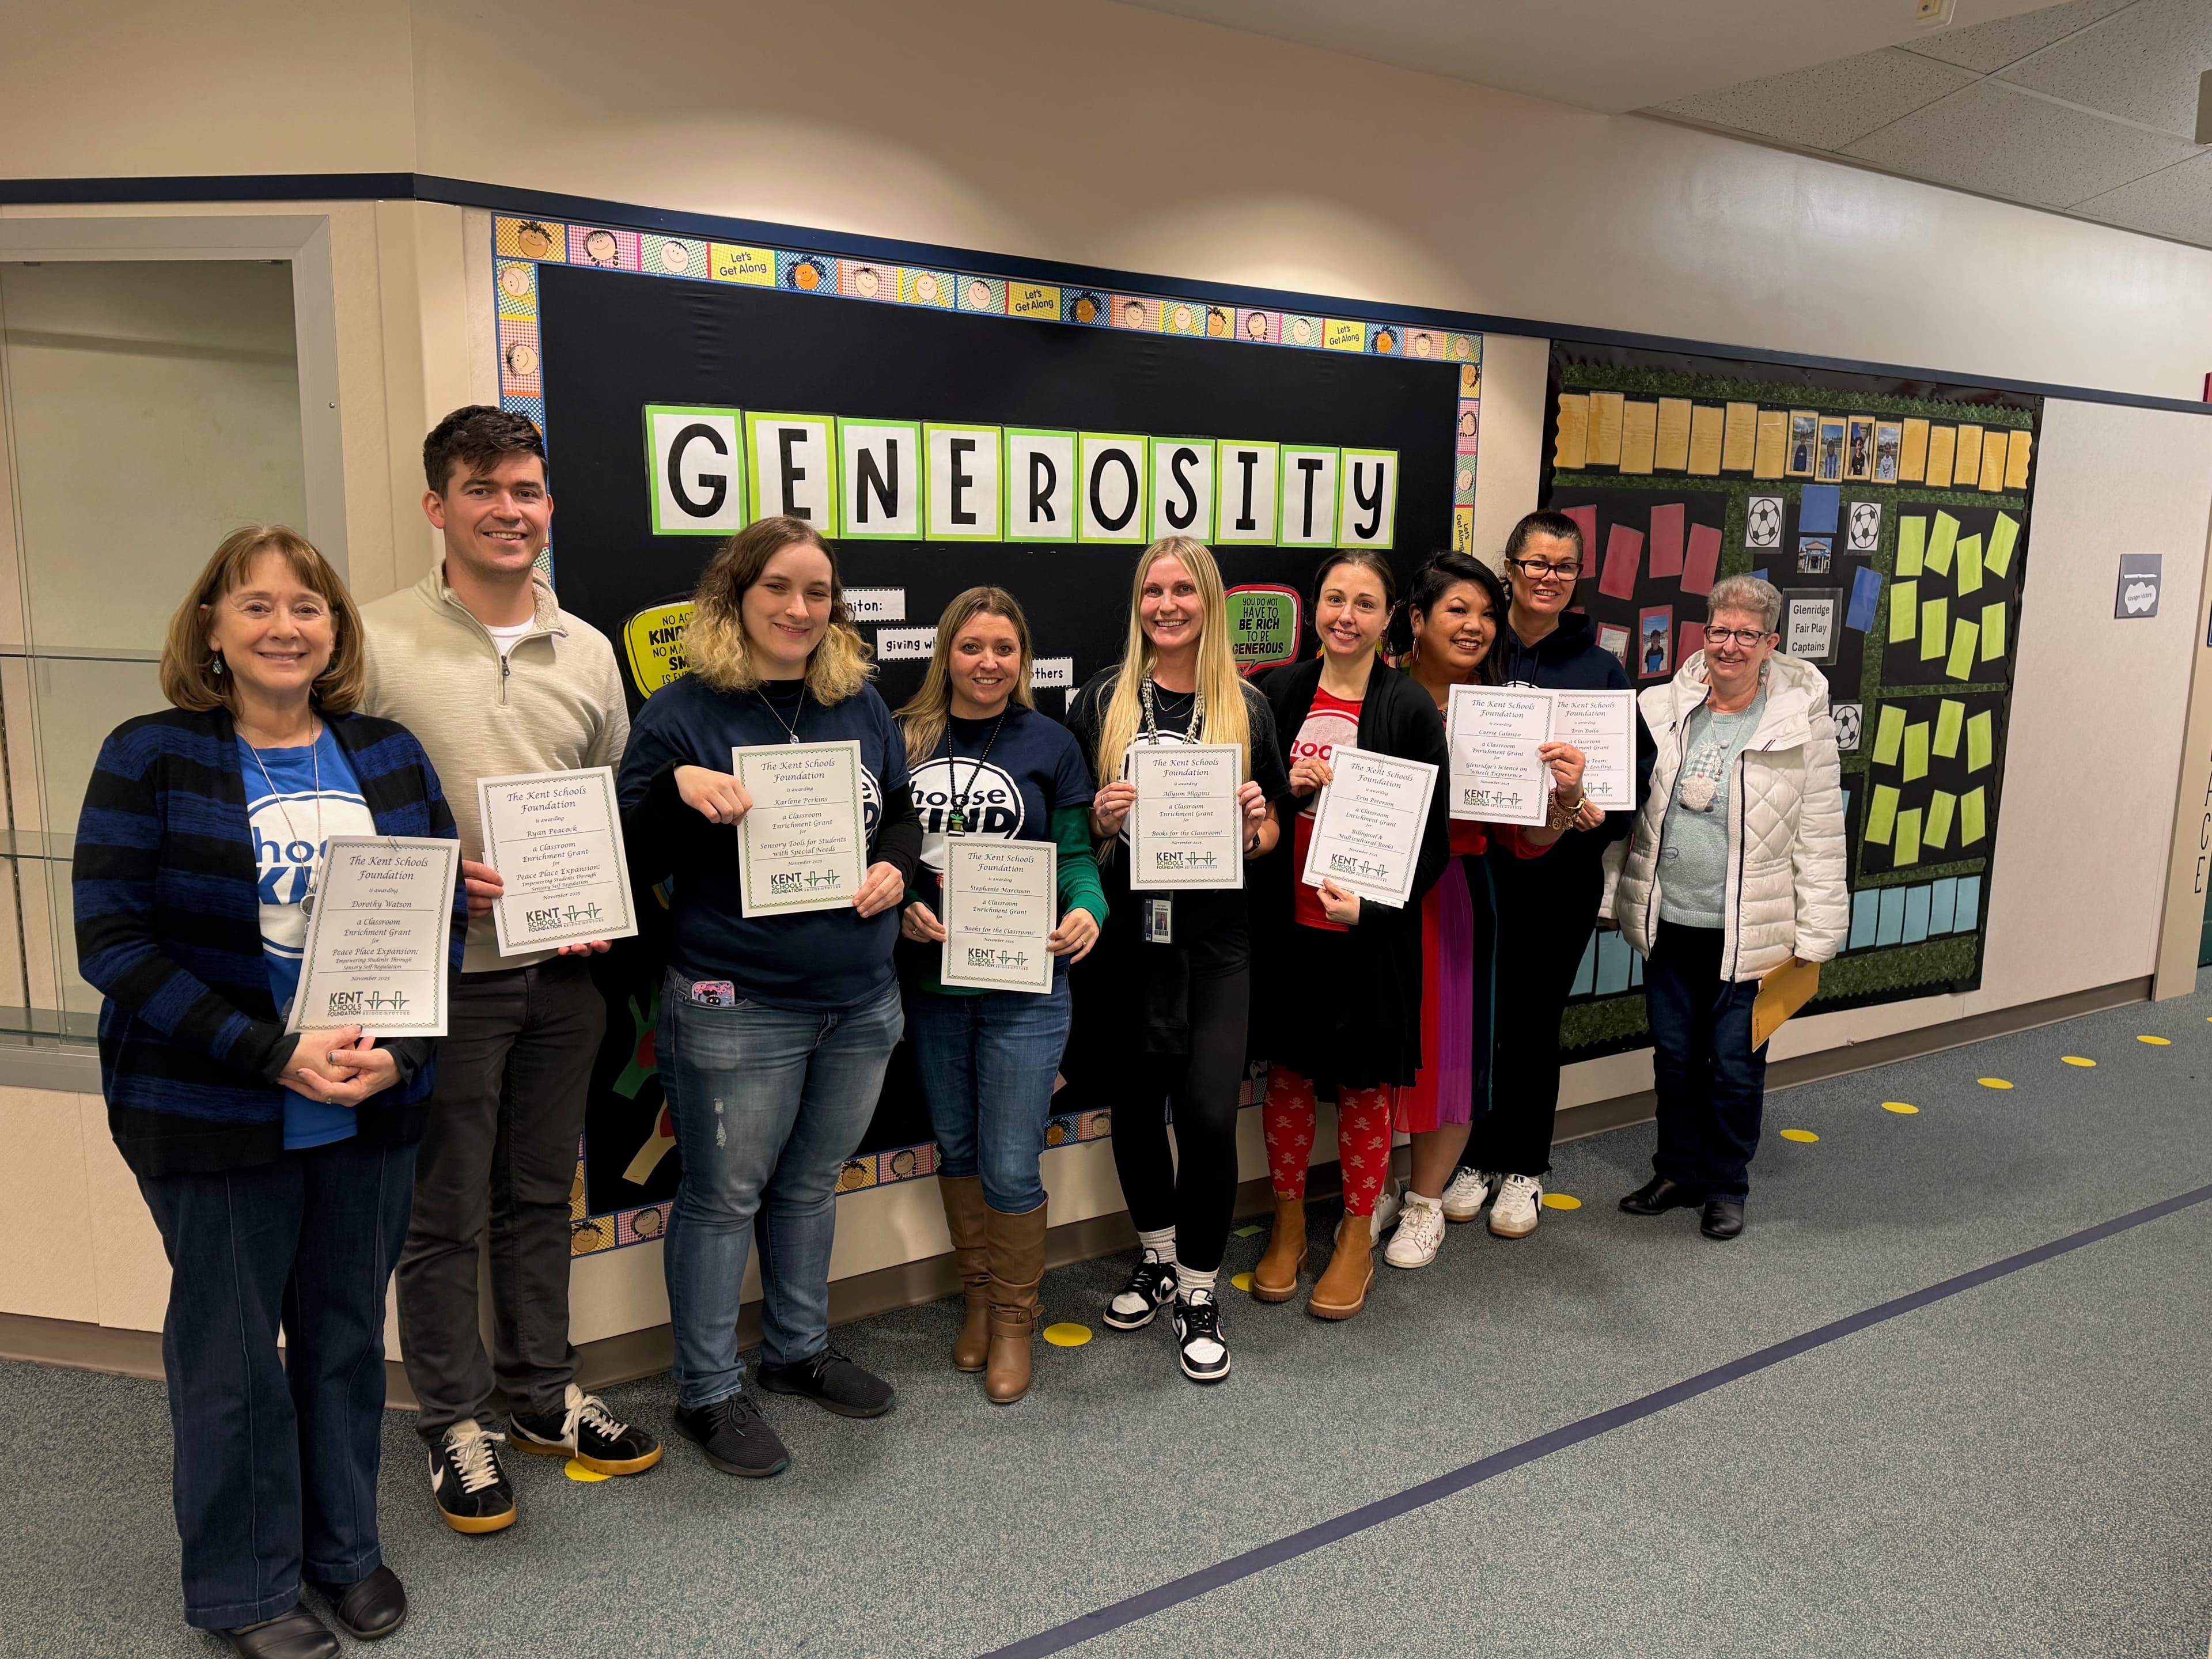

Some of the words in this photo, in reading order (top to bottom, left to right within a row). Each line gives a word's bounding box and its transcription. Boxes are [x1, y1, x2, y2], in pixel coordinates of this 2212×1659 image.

[730, 252, 752, 263] Let's
[719, 264, 737, 276] Get
[739, 262, 767, 275] Along
[1024, 290, 1042, 300] Let's
[1015, 301, 1032, 312] Get
[1033, 298, 1054, 310] Along
[1336, 325, 1351, 335] Let's
[1330, 336, 1342, 345] Get
[1343, 332, 1359, 344] Along
[666, 423, 1385, 541] GENEROSITY
[1243, 598, 1255, 606] YOU
[1243, 607, 1265, 619] HAVE
[1267, 607, 1278, 619] TO
[1793, 605, 1830, 615] Glenridge
[662, 615, 676, 626] NO
[1239, 619, 1252, 631] BE
[1256, 618, 1280, 630] RICH
[1796, 623, 1810, 633] Fair
[1811, 623, 1827, 635] Play
[1247, 631, 1257, 642] TO
[1260, 631, 1269, 642] BE
[887, 640, 920, 652] giving
[1233, 642, 1283, 654] GENEROUS
[1792, 642, 1825, 653] Captains
[653, 647, 666, 658] NO
[661, 675, 671, 685] IS
[1487, 700, 1506, 709] Kent
[1508, 702, 1535, 710] Schools
[1479, 710, 1524, 719] Foundation
[760, 763, 777, 771] The
[780, 761, 802, 770] Kent
[805, 758, 835, 768] Schools
[774, 772, 824, 783] Foundation
[1162, 770, 1209, 778] Foundation
[1351, 763, 1364, 771] The
[1365, 766, 1384, 775] Kent
[1386, 770, 1413, 782] Schools
[1357, 774, 1402, 789] Foundation
[507, 793, 523, 802] The
[526, 790, 550, 800] Kent
[553, 786, 586, 798] Schools
[911, 781, 1006, 806] hoose
[1464, 789, 1490, 799] KENT
[520, 800, 576, 814] Foundation
[1370, 798, 1395, 807] Peterson
[789, 812, 821, 820] Classroom
[772, 821, 811, 830] Enrichment
[527, 830, 546, 839] Ryan
[548, 825, 577, 835] Peacock
[1351, 829, 1377, 839] Bilingual
[539, 842, 575, 852] Classroom
[760, 842, 786, 850] Sensory
[806, 839, 816, 847] for
[1338, 834, 1377, 846] Multicultural
[1378, 842, 1394, 850] Books
[522, 853, 565, 862] Enrichment
[567, 849, 589, 858] Grant
[790, 848, 813, 856] Special
[1157, 852, 1183, 861] KENT
[349, 856, 367, 865] The
[369, 857, 392, 866] Kent
[395, 857, 429, 867] Schools
[967, 853, 982, 861] The
[1006, 855, 1034, 863] Schools
[1332, 853, 1358, 865] KENT
[516, 872, 537, 881] Peace
[539, 869, 559, 877] Place
[560, 864, 601, 876] Expansion:
[978, 864, 1024, 873] Foundation
[358, 870, 414, 881] Foundation
[771, 873, 801, 885] KENT
[351, 900, 382, 910] Dorothy
[526, 907, 559, 922] KENT
[343, 929, 387, 937] Enrichment
[968, 948, 995, 958] KENT
[329, 991, 363, 1005] KENT
